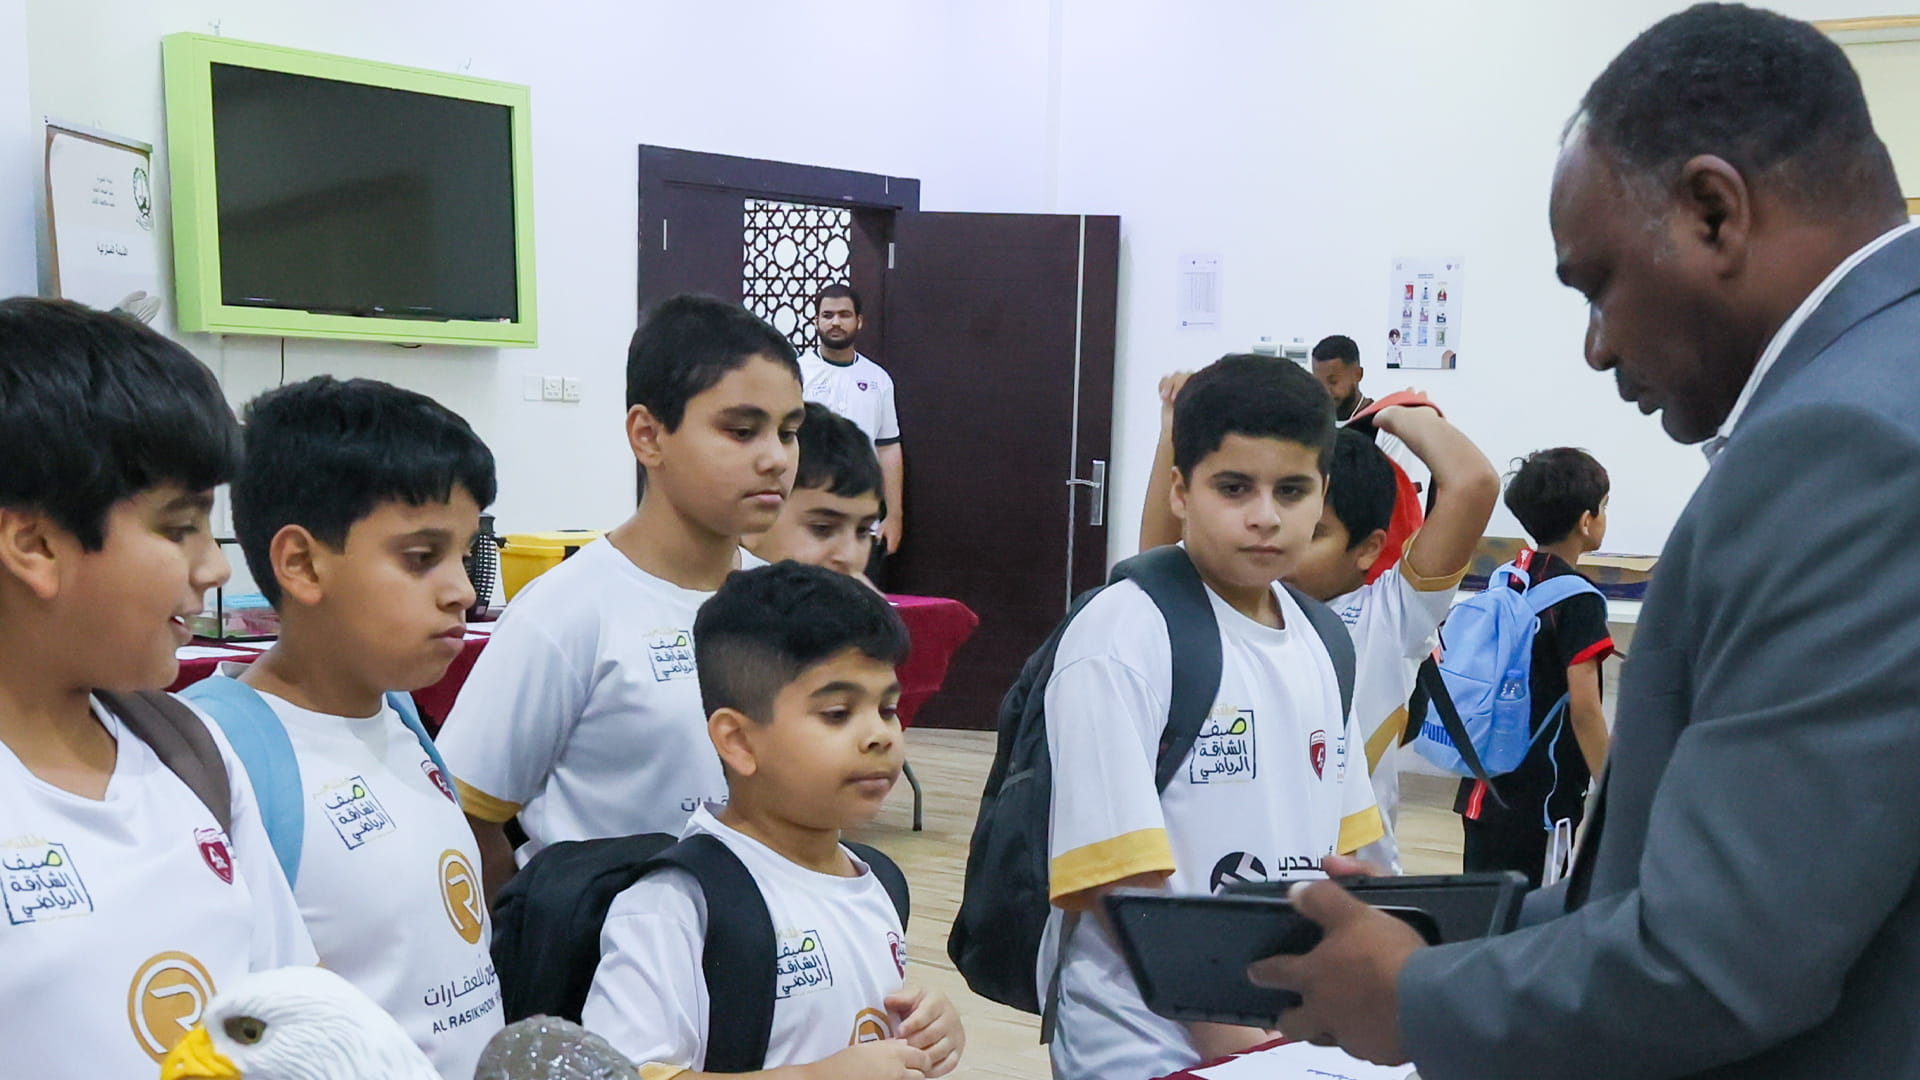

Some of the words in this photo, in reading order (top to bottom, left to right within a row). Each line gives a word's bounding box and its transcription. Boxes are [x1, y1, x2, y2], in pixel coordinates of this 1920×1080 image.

[1198, 716, 1248, 740] صيف
[1421, 720, 1453, 748] PUM
[1200, 756, 1251, 780] الرياضي
[325, 783, 366, 809] صيف
[2, 849, 63, 872] صيف
[10, 870, 75, 892] الشارقة
[22, 887, 85, 917] الرياضي
[776, 936, 816, 958] صيف
[781, 967, 828, 994] الرياضي
[432, 1019, 448, 1035] AL
